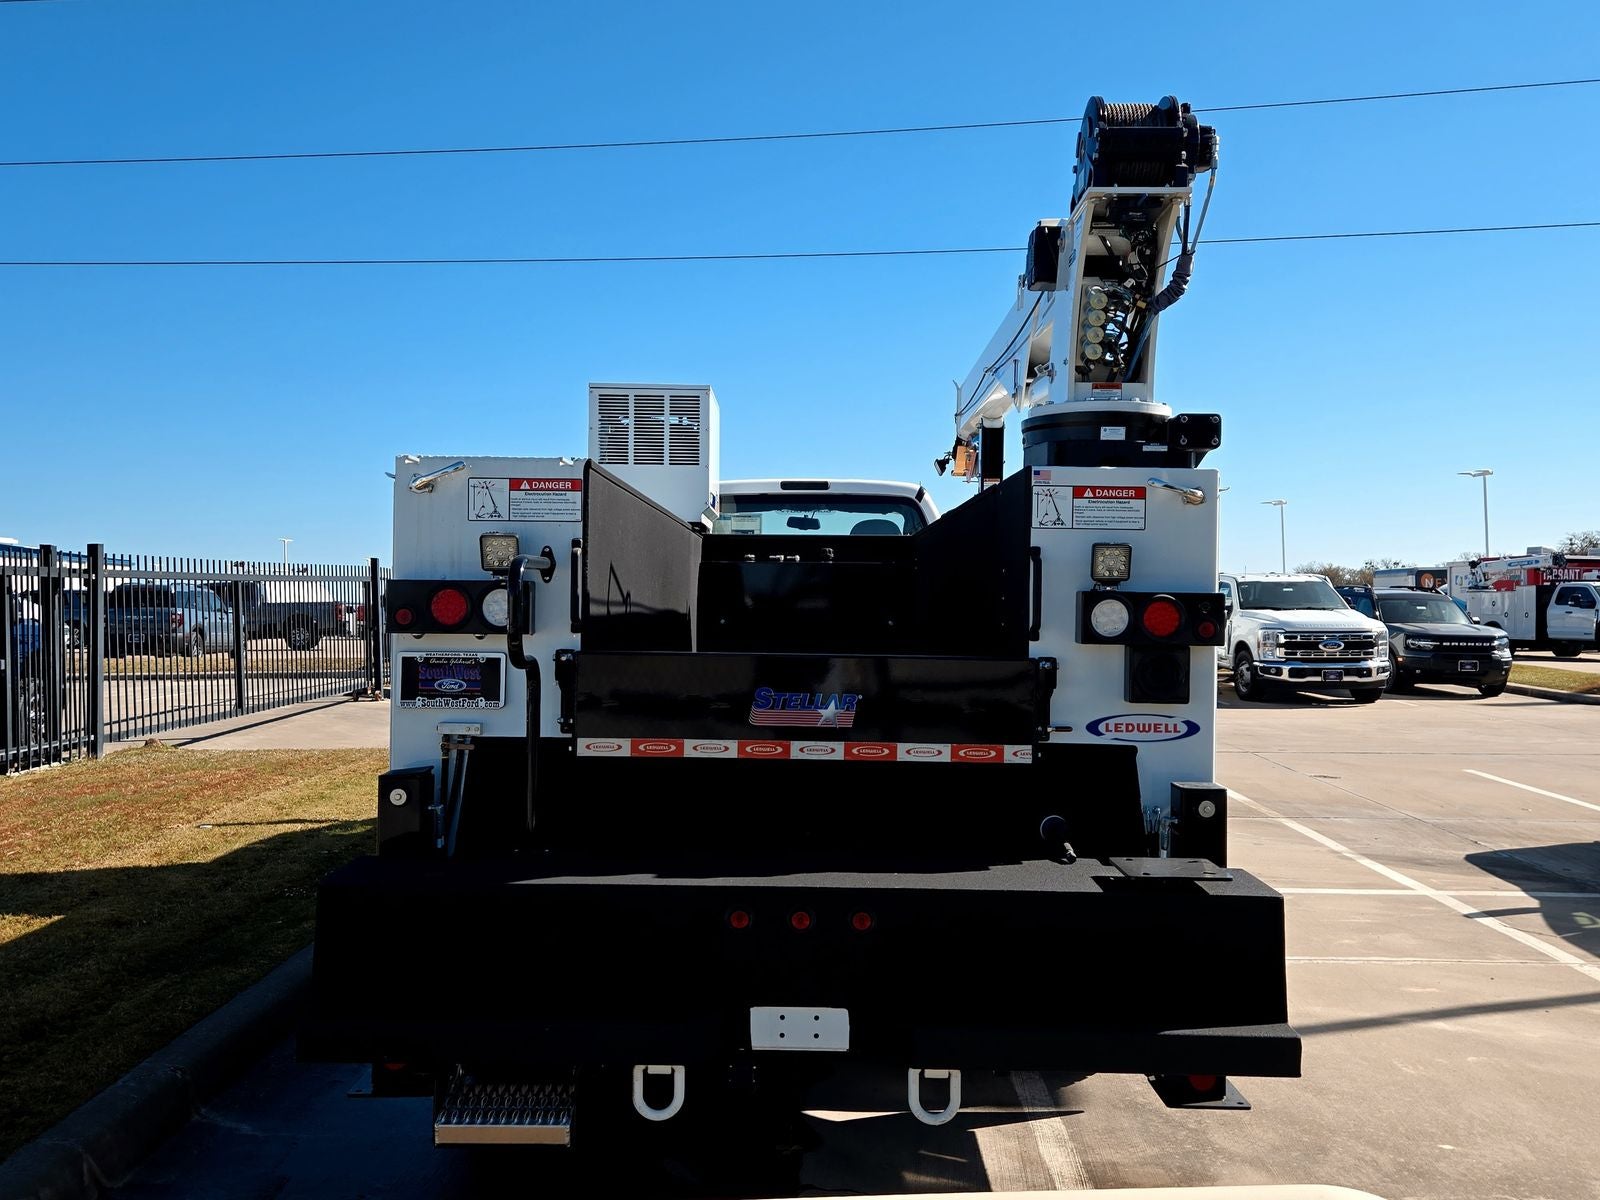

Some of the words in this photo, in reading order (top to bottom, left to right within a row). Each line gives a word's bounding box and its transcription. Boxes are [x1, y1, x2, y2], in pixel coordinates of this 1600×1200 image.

[532, 481, 572, 489] DANGER
[1095, 489, 1136, 497] DANGER
[441, 680, 460, 690] Ford
[1104, 722, 1181, 733] LEDWELL
